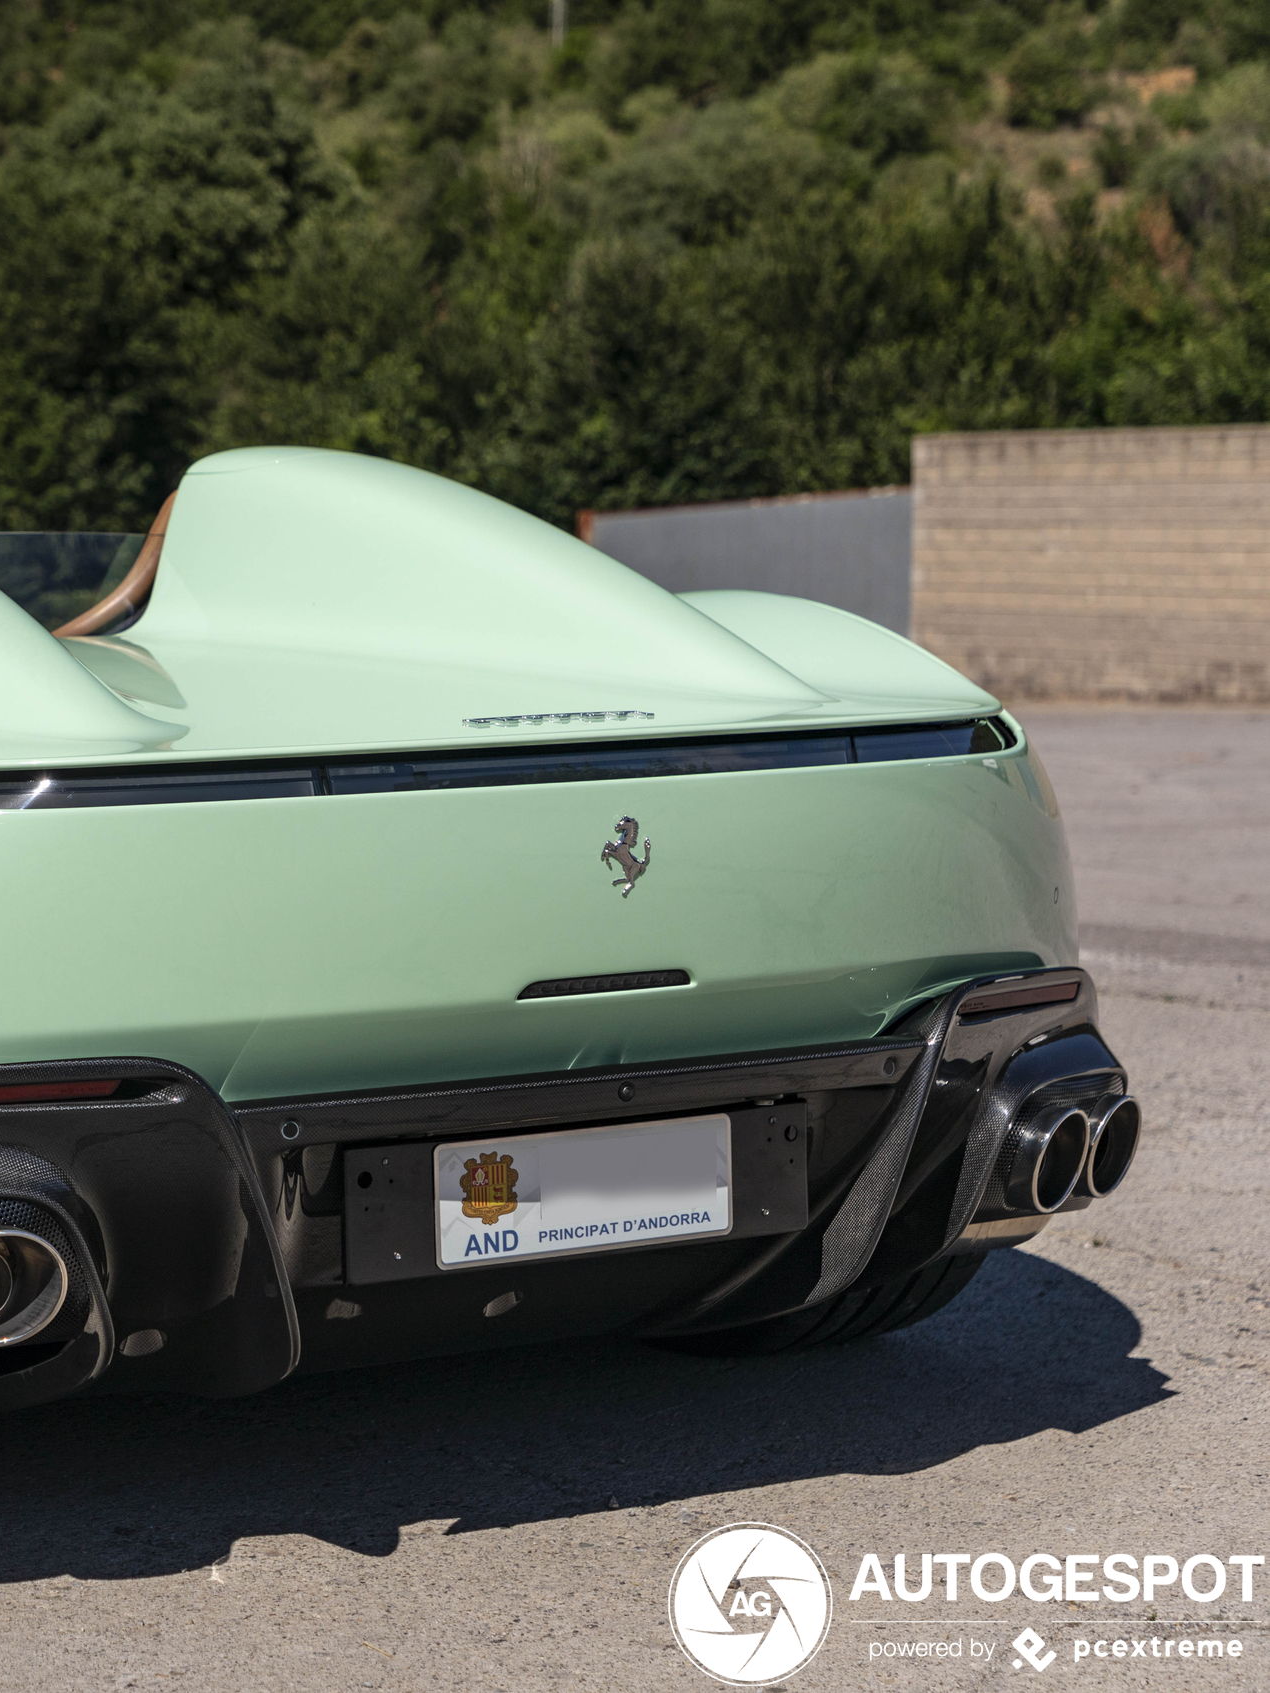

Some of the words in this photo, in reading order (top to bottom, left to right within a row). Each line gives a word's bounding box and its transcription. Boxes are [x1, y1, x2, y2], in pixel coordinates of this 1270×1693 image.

[539, 1222, 619, 1243] PRINCIPAT
[624, 1211, 711, 1233] D'ANDORRA
[465, 1229, 518, 1256] AND
